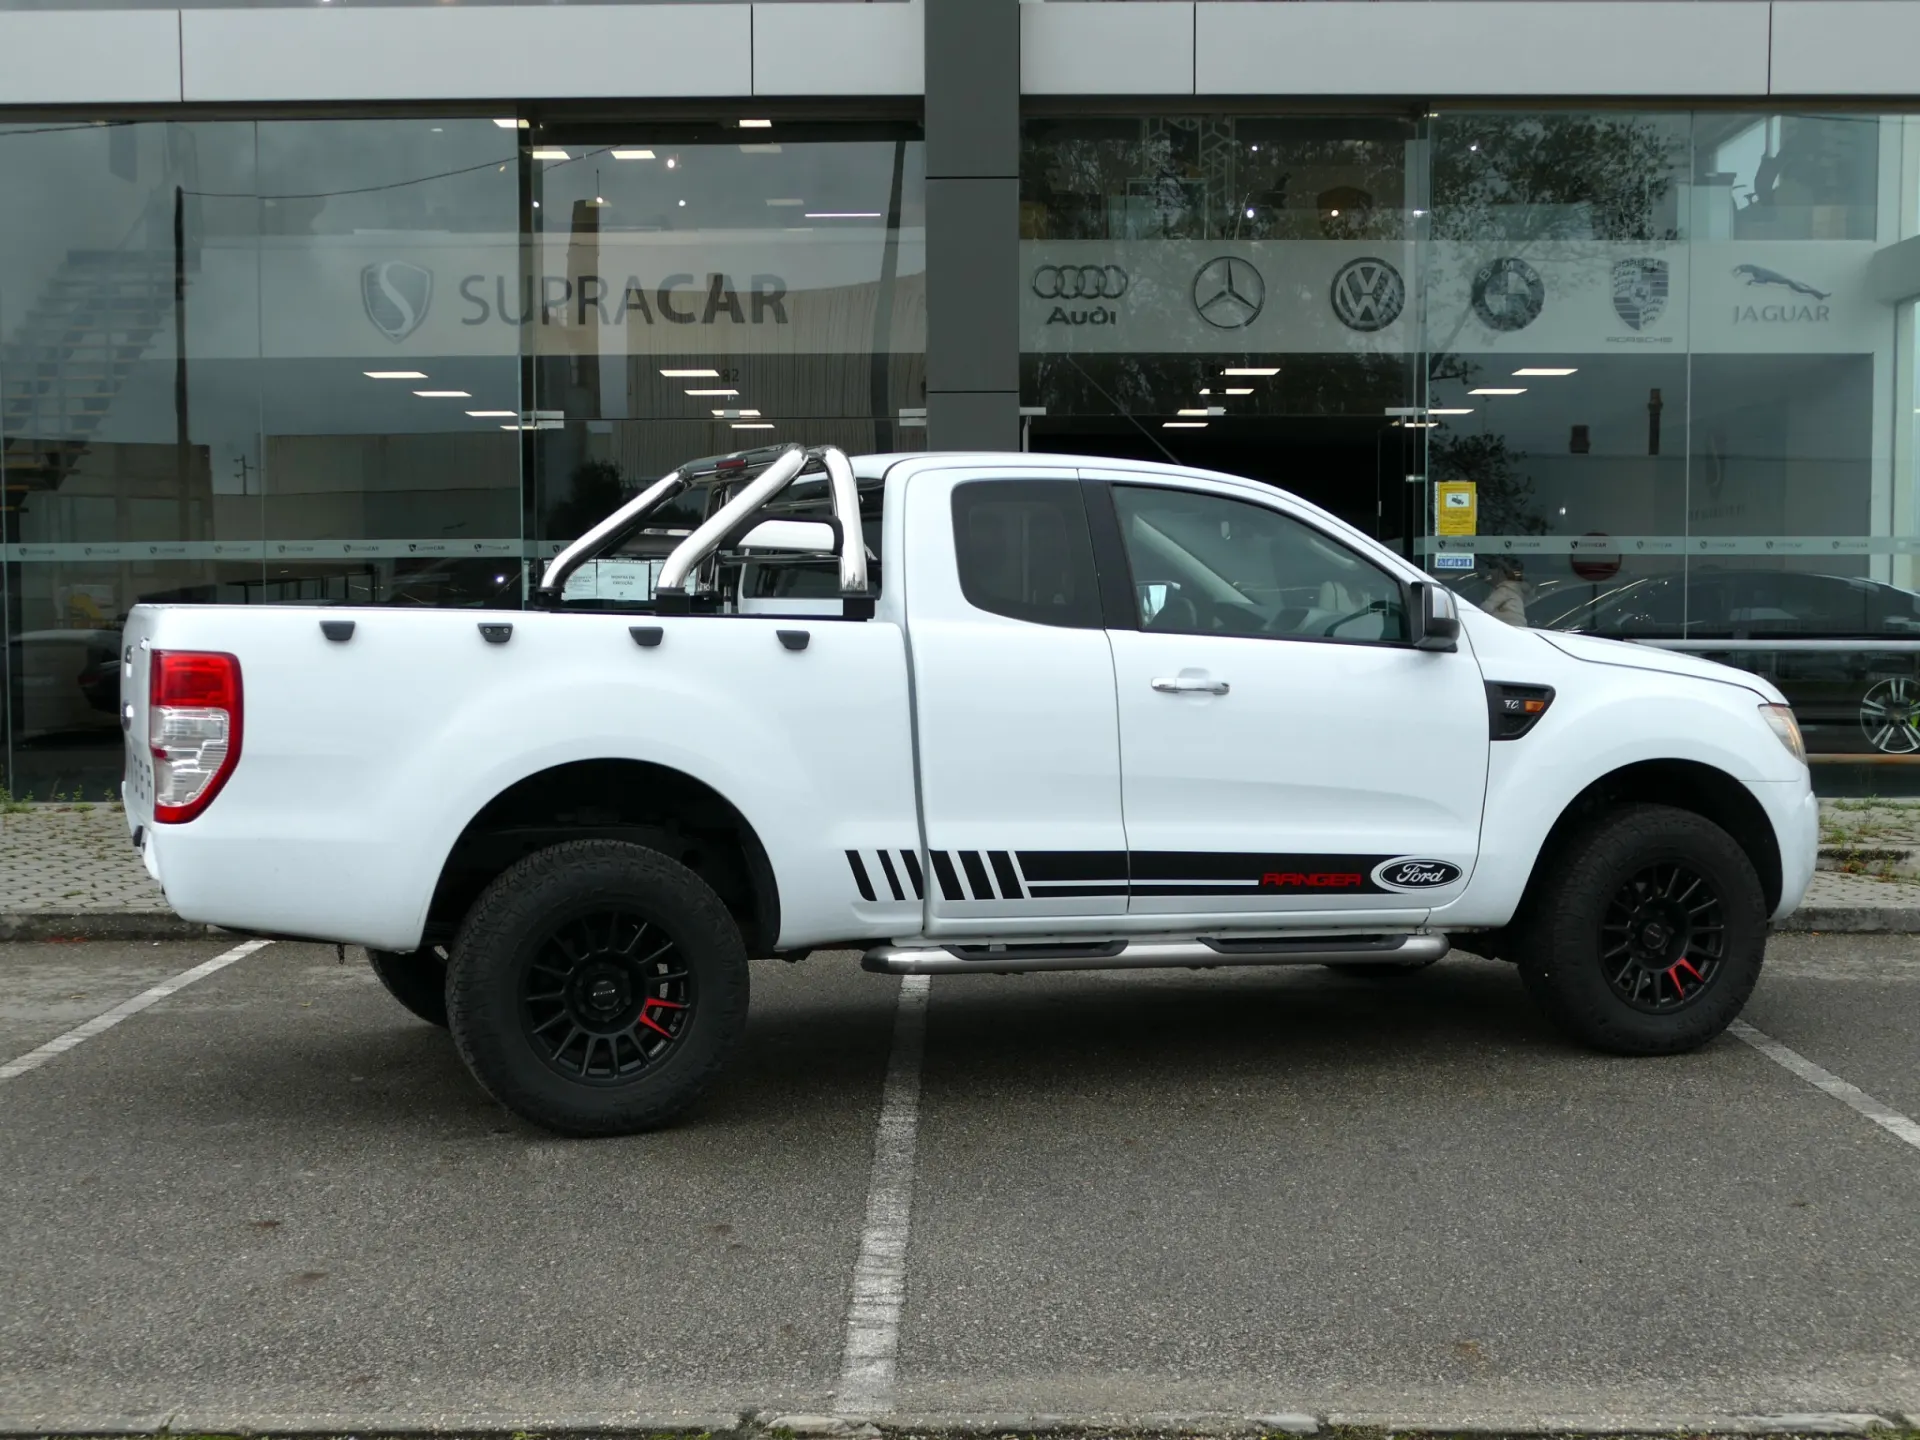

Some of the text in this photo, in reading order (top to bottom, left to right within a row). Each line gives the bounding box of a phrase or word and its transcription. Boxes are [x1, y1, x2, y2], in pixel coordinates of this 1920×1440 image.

[459, 272, 788, 326] SUPRACAR
[1045, 305, 1117, 326] Audi
[1733, 304, 1830, 324] JAGUAR
[722, 368, 740, 382] 82
[1263, 873, 1362, 887] RANGER
[1396, 863, 1446, 883] Ford
